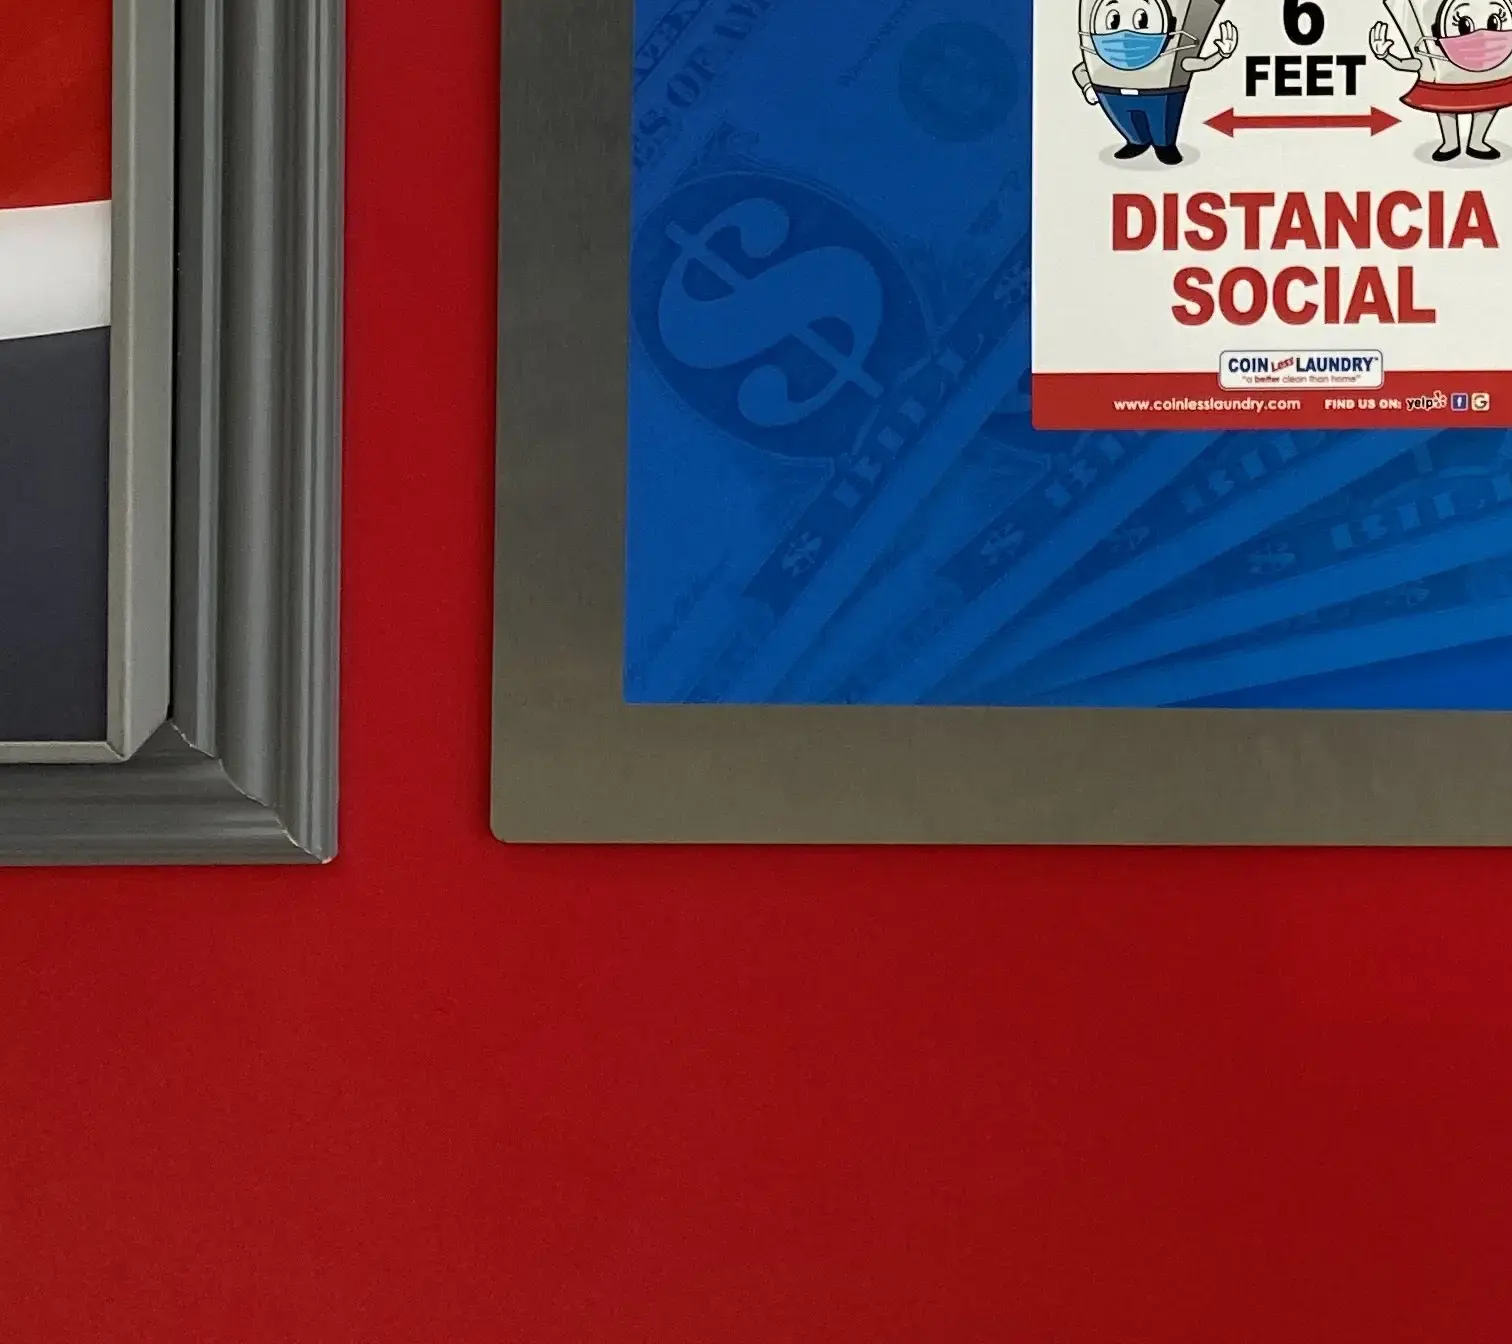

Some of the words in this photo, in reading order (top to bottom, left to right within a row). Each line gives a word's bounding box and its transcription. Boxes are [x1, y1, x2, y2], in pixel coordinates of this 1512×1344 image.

[1246, 55, 1366, 96] FEET
[1113, 190, 1498, 251] DISTANCIA
[1172, 266, 1436, 326] SOCIAL
[1228, 357, 1269, 373] COIN
[1271, 357, 1294, 373] Less
[1113, 398, 1300, 412] www.coinlesslaundry.com
[1325, 399, 1354, 409] FIND
[1359, 399, 1376, 409] US
[1380, 399, 1402, 409] ON:
[1406, 397, 1433, 412] yelp
